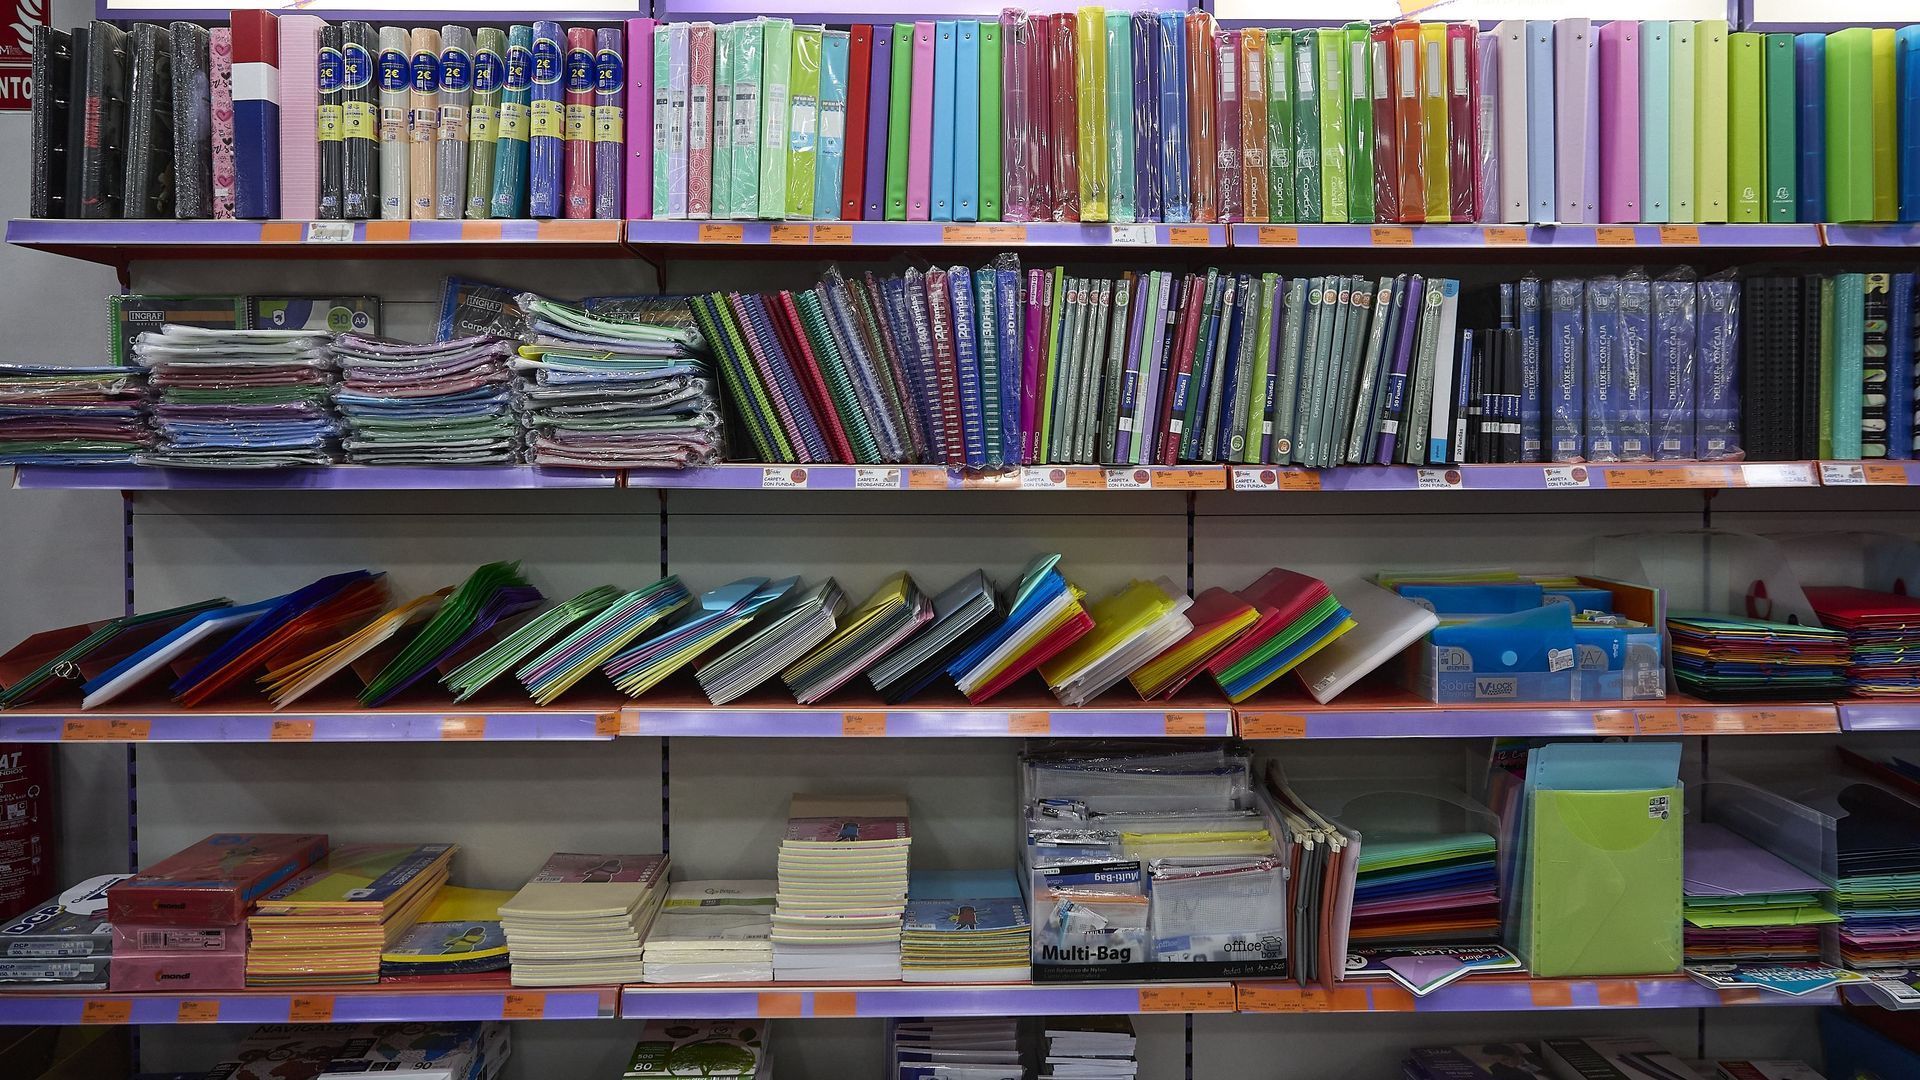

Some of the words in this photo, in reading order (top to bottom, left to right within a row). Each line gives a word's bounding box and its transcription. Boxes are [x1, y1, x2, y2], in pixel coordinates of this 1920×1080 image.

[345, 64, 358, 74] 2€
[536, 59, 551, 69] 2€
[320, 68, 333, 78] 2€
[384, 69, 399, 78] 2€
[417, 70, 432, 80] 2€
[446, 67, 461, 77] 2€
[477, 69, 490, 79] 2€
[509, 66, 523, 76] 2€
[571, 68, 585, 78] 2€
[600, 69, 613, 79] 2€
[468, 297, 501, 311] INGRAF
[1007, 290, 1015, 321] Fundas
[131, 311, 162, 320] INGRAF
[330, 314, 348, 324] 30
[354, 316, 367, 325] A4
[461, 320, 497, 334] Carpeta
[1007, 321, 1016, 336] 30
[1528, 325, 1536, 346] CAJA
[1599, 325, 1607, 346] CAJA
[1669, 325, 1677, 346] CAJA
[1713, 325, 1721, 346] CAJA
[1162, 345, 1170, 364] Fundas
[1528, 347, 1536, 363] CON
[1599, 347, 1607, 363] CON
[1669, 347, 1677, 363] CON
[1713, 347, 1721, 363] CON
[1126, 376, 1134, 396] Fundas
[1177, 379, 1187, 398] Fundas
[1528, 365, 1536, 400] DELUXE+
[1599, 365, 1607, 400] DELUXE+
[1669, 365, 1677, 400] DELUXE+
[1713, 365, 1721, 400] DELUXE+
[1266, 380, 1275, 400] Fundas
[1394, 379, 1403, 399] Fundas
[1125, 396, 1132, 404] 50
[1177, 398, 1184, 406] 30
[1266, 400, 1272, 408] 10
[1393, 400, 1400, 408] 50
[1457, 428, 1465, 448] Fundas
[1456, 448, 1463, 456] 20
[1451, 652, 1470, 666] DL
[1585, 652, 1602, 664] A7
[1440, 679, 1474, 691] Sobre
[1094, 871, 1139, 882] Multi-Bag
[157, 901, 186, 909] mondi
[1, 904, 61, 934] DCP
[1223, 942, 1261, 953] office
[1042, 945, 1131, 963] Multi-Bag
[1261, 950, 1278, 959] box
[160, 972, 191, 980] mondi
[413, 1062, 433, 1070] 90
[633, 1063, 652, 1071] 80
